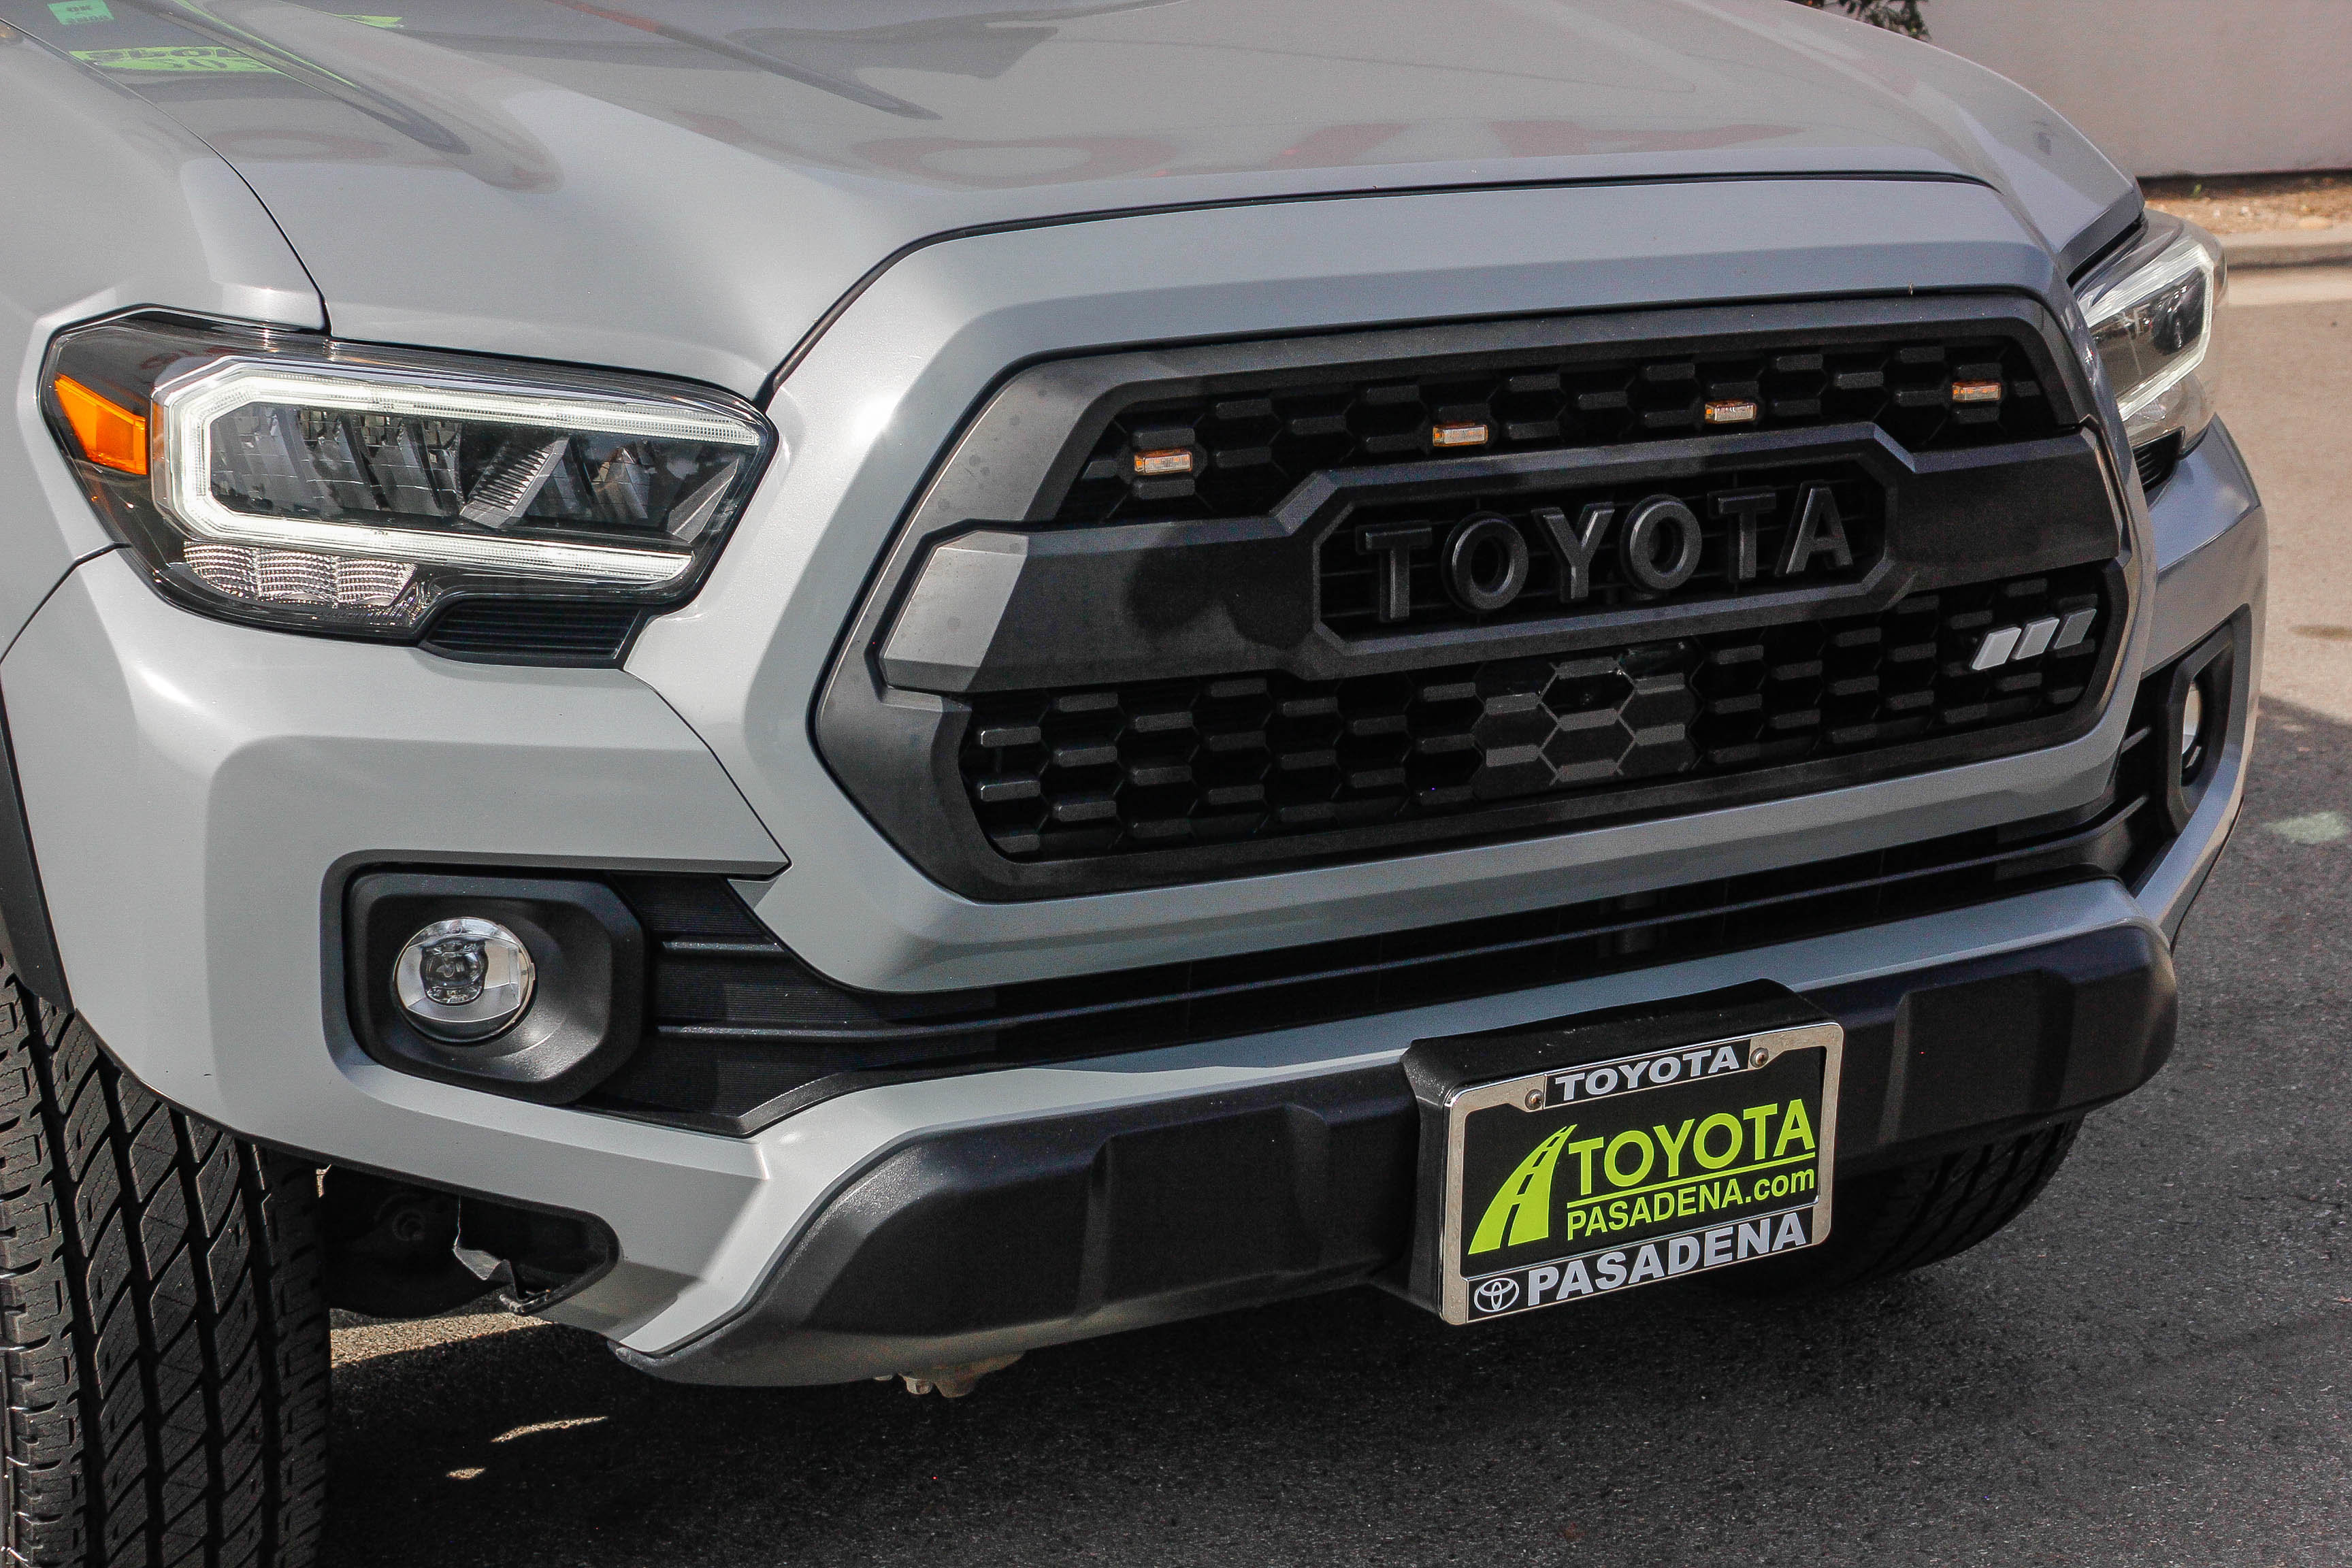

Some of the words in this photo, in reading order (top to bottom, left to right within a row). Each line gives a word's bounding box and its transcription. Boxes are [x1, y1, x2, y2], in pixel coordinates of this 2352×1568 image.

[1357, 480, 1854, 622] TOYOTA
[1555, 1045, 1740, 1101] TOYOTA
[1567, 1098, 1815, 1196] TOYOTA
[1567, 1166, 1814, 1241] PASADENA.com
[1527, 1211, 1806, 1307] PASADENA
